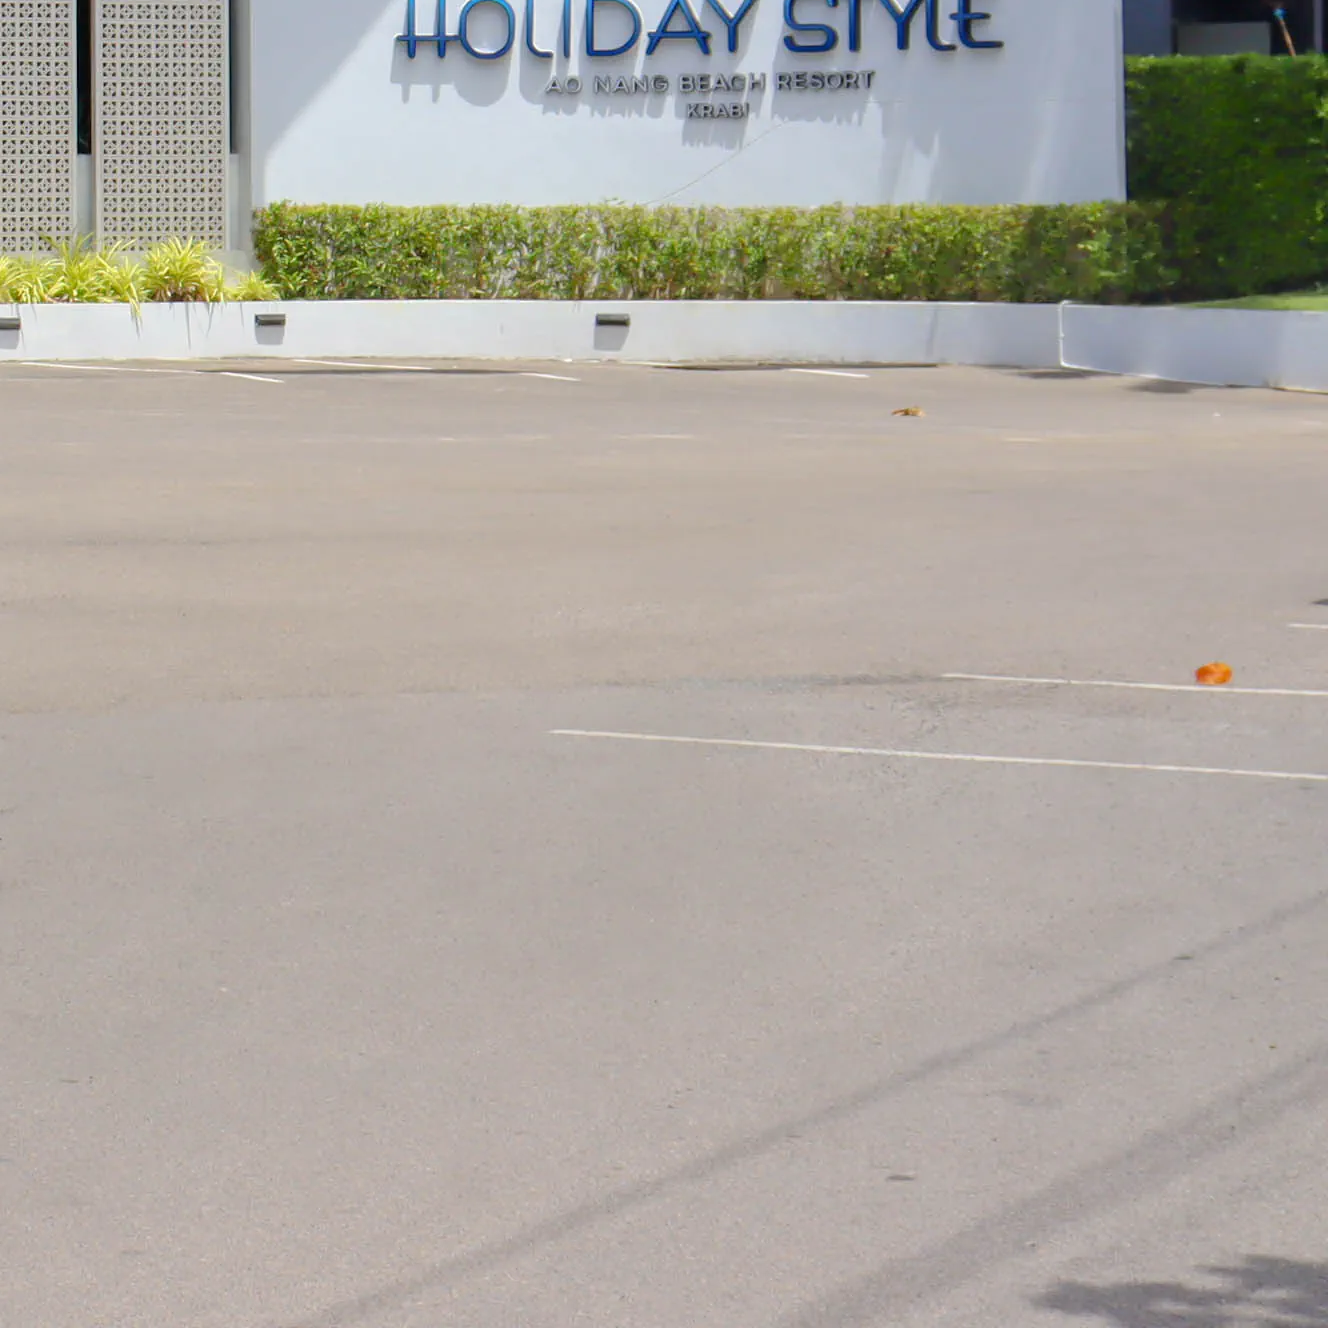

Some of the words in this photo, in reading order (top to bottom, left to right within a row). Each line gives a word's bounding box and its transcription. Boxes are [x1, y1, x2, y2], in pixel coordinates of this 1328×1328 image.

[545, 75, 582, 94] AO
[593, 75, 669, 94] NANG
[679, 72, 766, 93] BEACH
[776, 70, 875, 91] RESORT
[687, 101, 750, 119] KRABI
